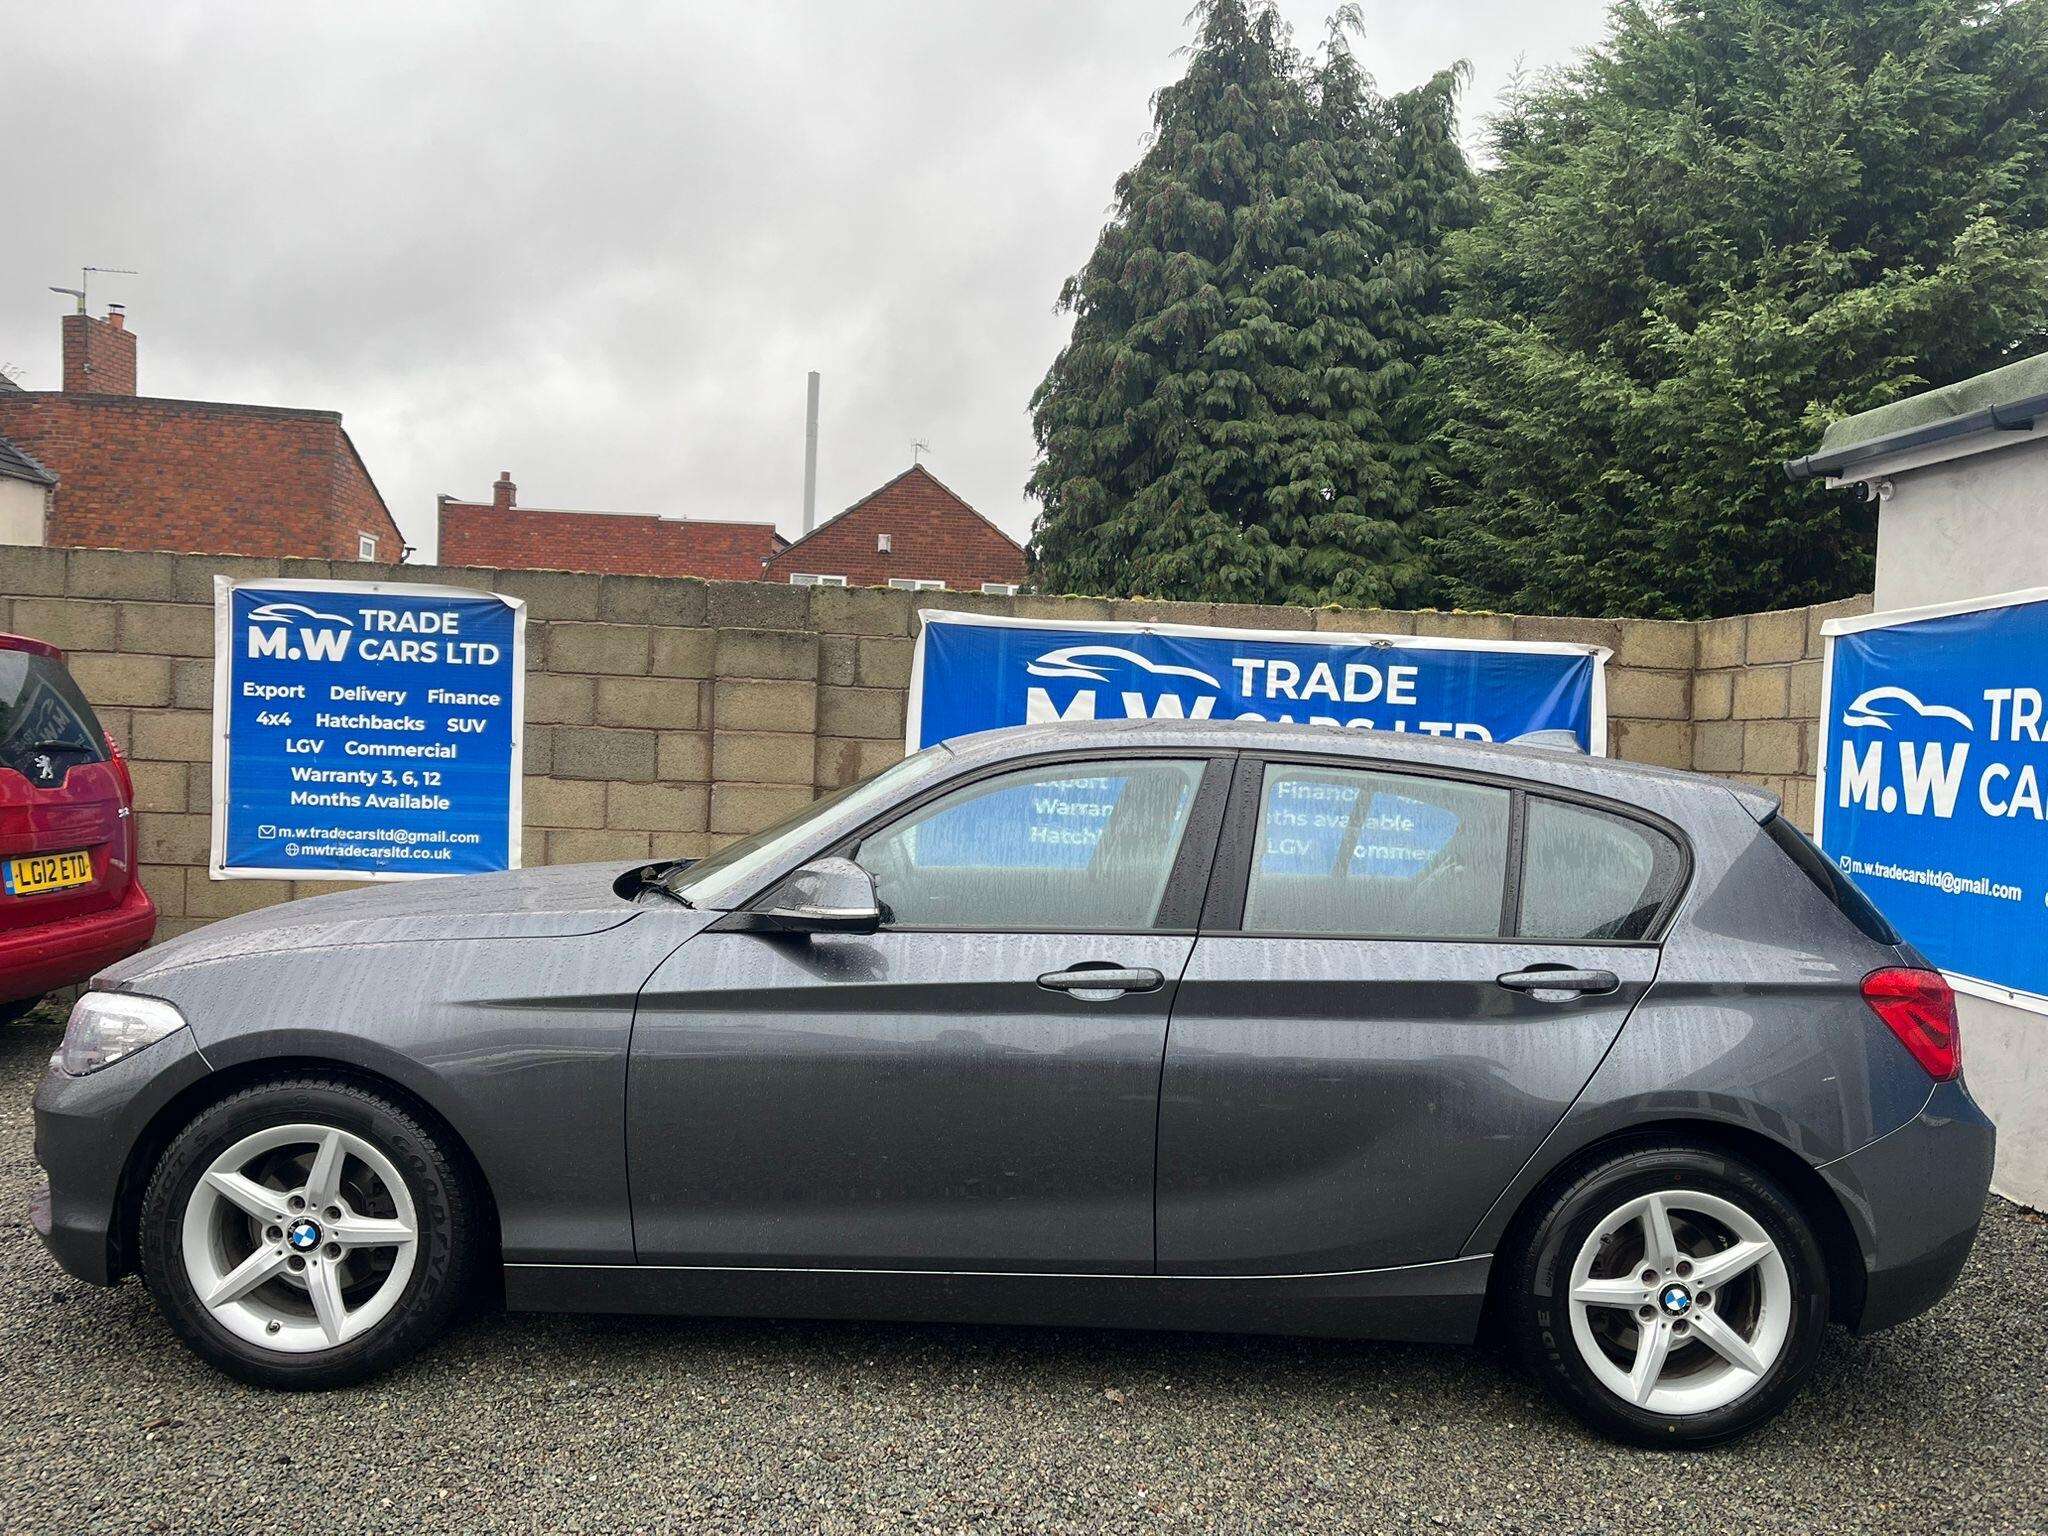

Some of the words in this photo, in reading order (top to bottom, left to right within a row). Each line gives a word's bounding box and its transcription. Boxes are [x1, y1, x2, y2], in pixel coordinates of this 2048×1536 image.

[359, 609, 459, 635] TRADE
[249, 626, 351, 661] M.W
[358, 639, 438, 662] CARS
[446, 643, 500, 665] LTD
[243, 681, 306, 700] Export
[330, 685, 407, 706] Delivery
[428, 688, 501, 706] Finance
[1231, 658, 1418, 705] TRADE
[256, 711, 292, 726] 4x4
[316, 713, 425, 731] Hatchbacks
[446, 718, 487, 733] SUV
[1983, 687, 2048, 742] TR
[286, 738, 324, 754] LGV
[344, 741, 456, 758] Commercial
[291, 767, 378, 787] Warranty
[381, 770, 398, 787] 3,
[402, 771, 419, 788] 6,
[422, 771, 441, 786] 12
[1839, 740, 1970, 818] M.W
[290, 791, 361, 807] Months
[365, 793, 450, 810] Available
[1978, 762, 2048, 820] CA
[1035, 799, 1114, 817] Warran
[278, 827, 480, 844] m.w.tradecarsltd@gmail.com
[301, 843, 451, 860] mwtradecarsltd.co.uk
[17, 859, 58, 887] LG12
[60, 854, 86, 881] ETD
[1852, 861, 2022, 901] m.w.tradecarsltd@gmail.com
